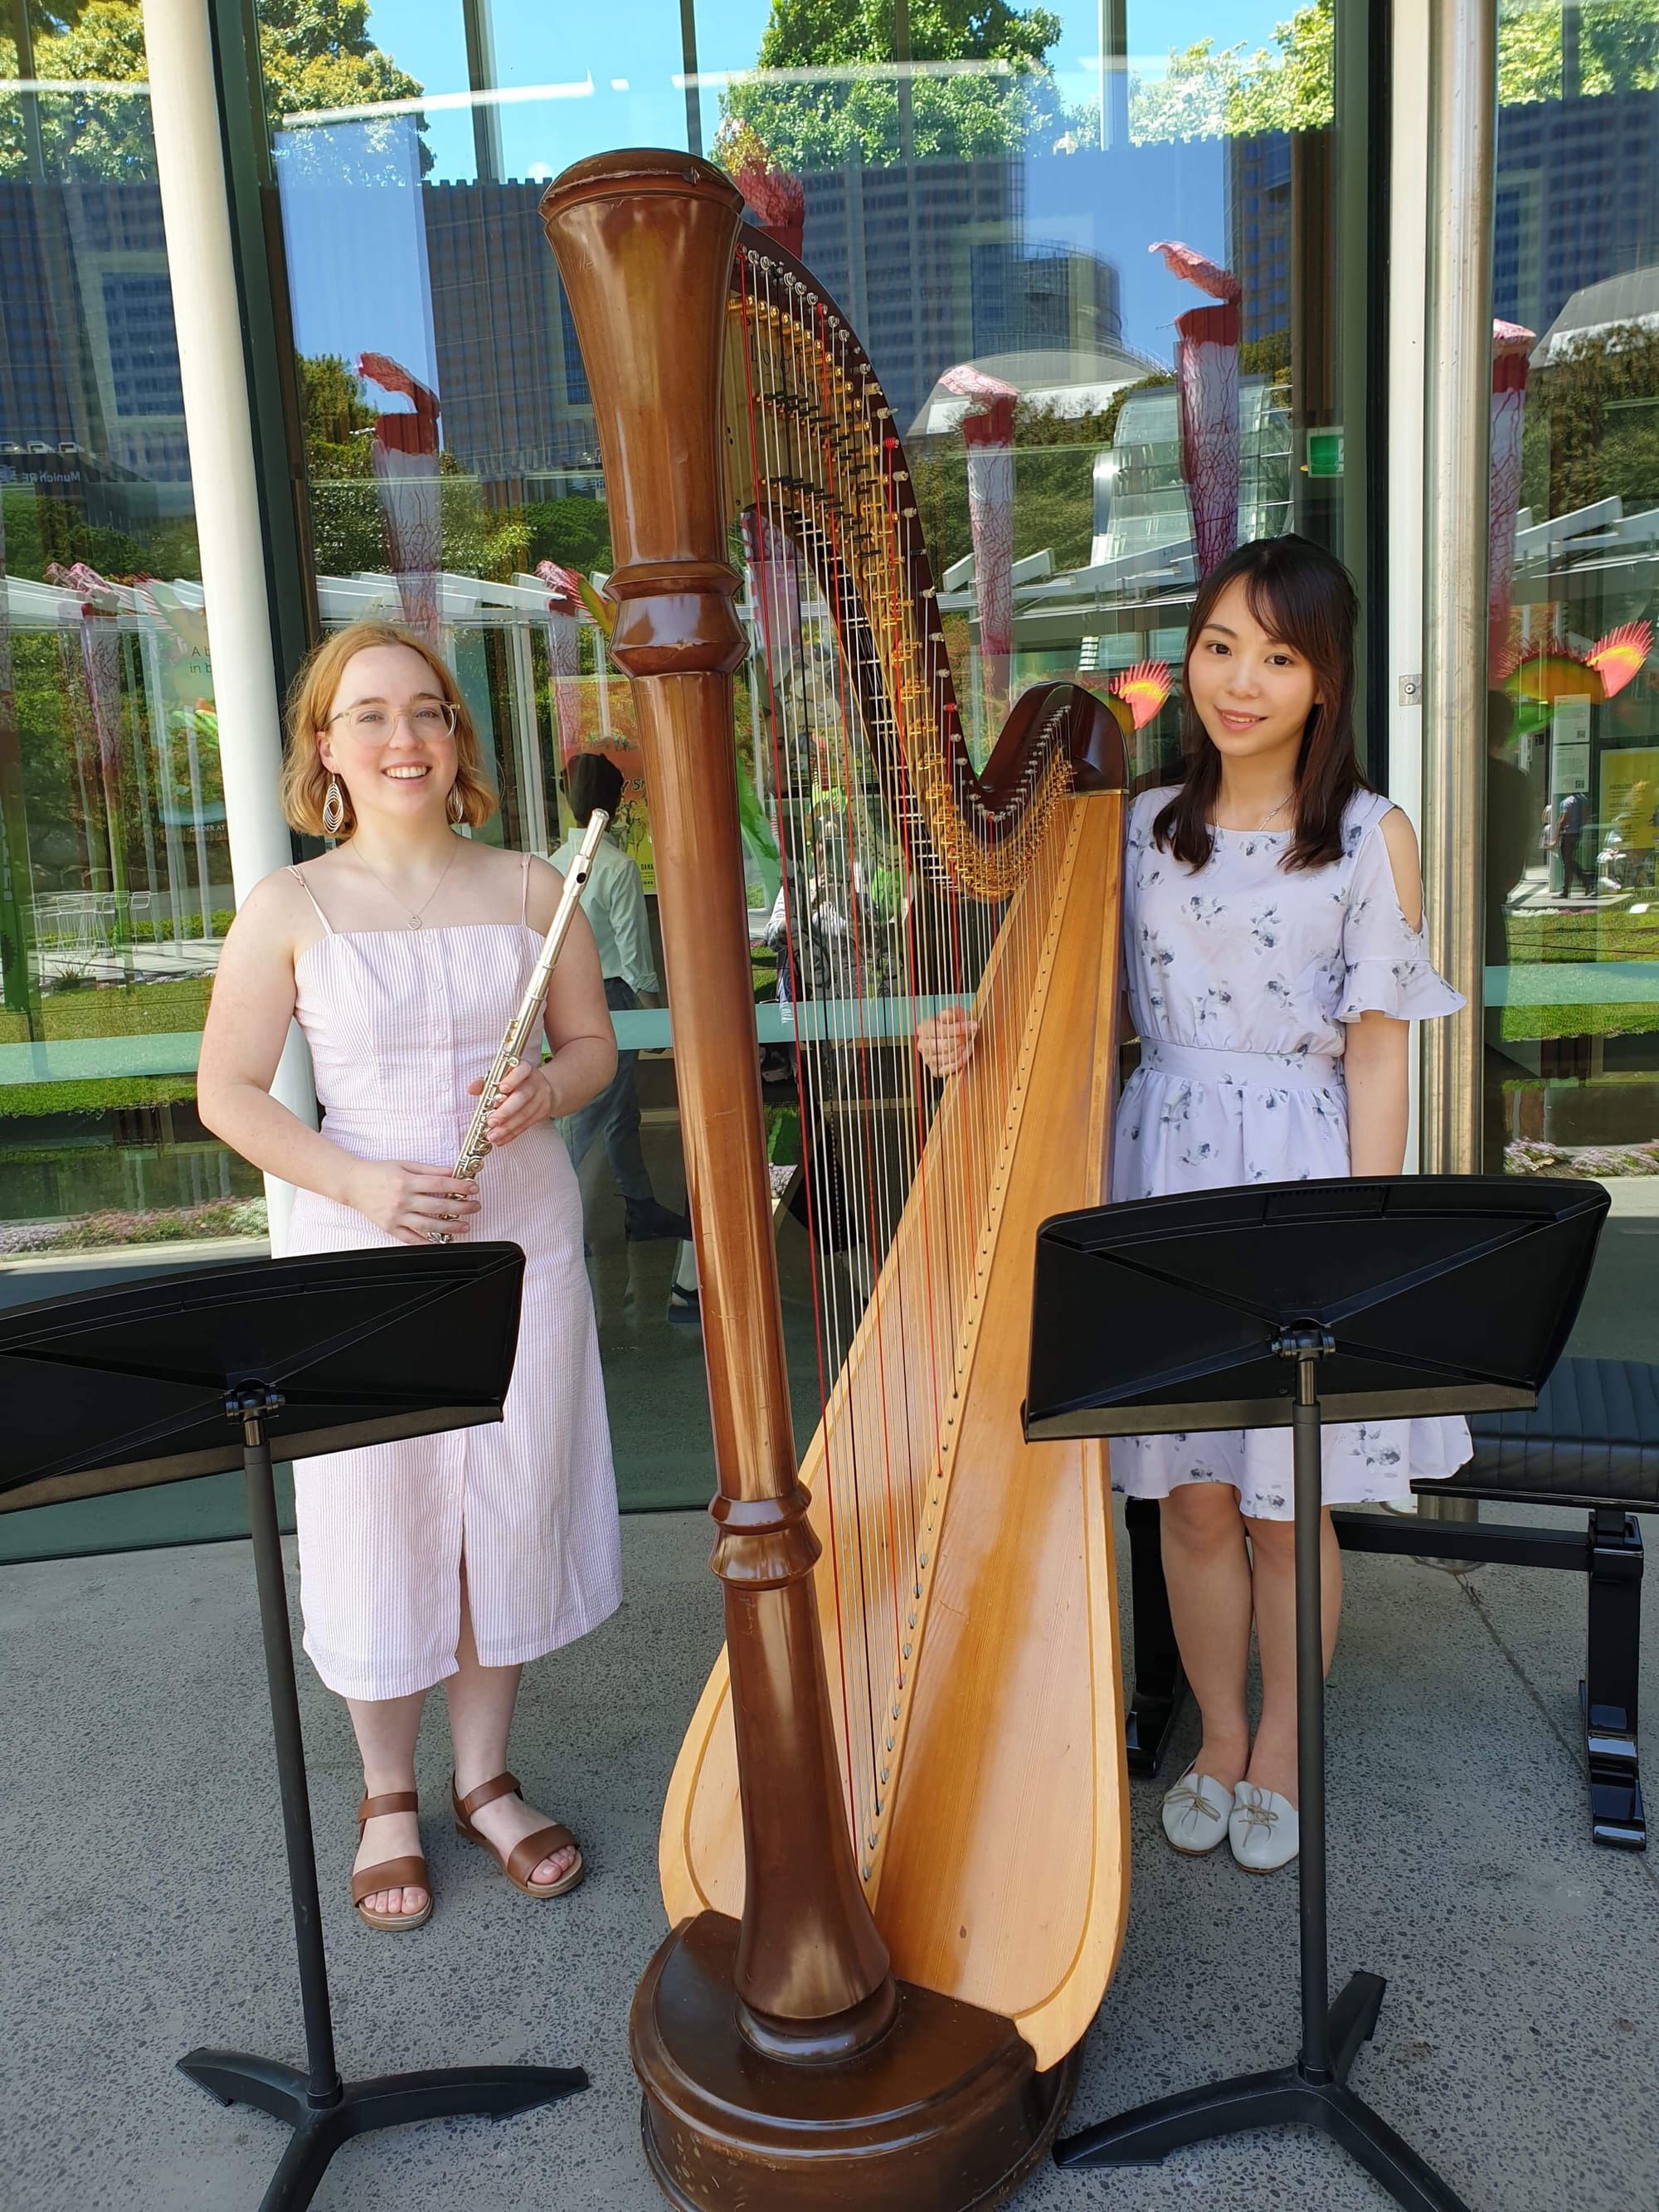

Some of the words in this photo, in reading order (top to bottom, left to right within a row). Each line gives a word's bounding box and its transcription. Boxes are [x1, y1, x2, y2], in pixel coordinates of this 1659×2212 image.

[192, 646, 202, 657] A
[189, 663, 201, 673] in
[190, 824, 215, 833] ORDER
